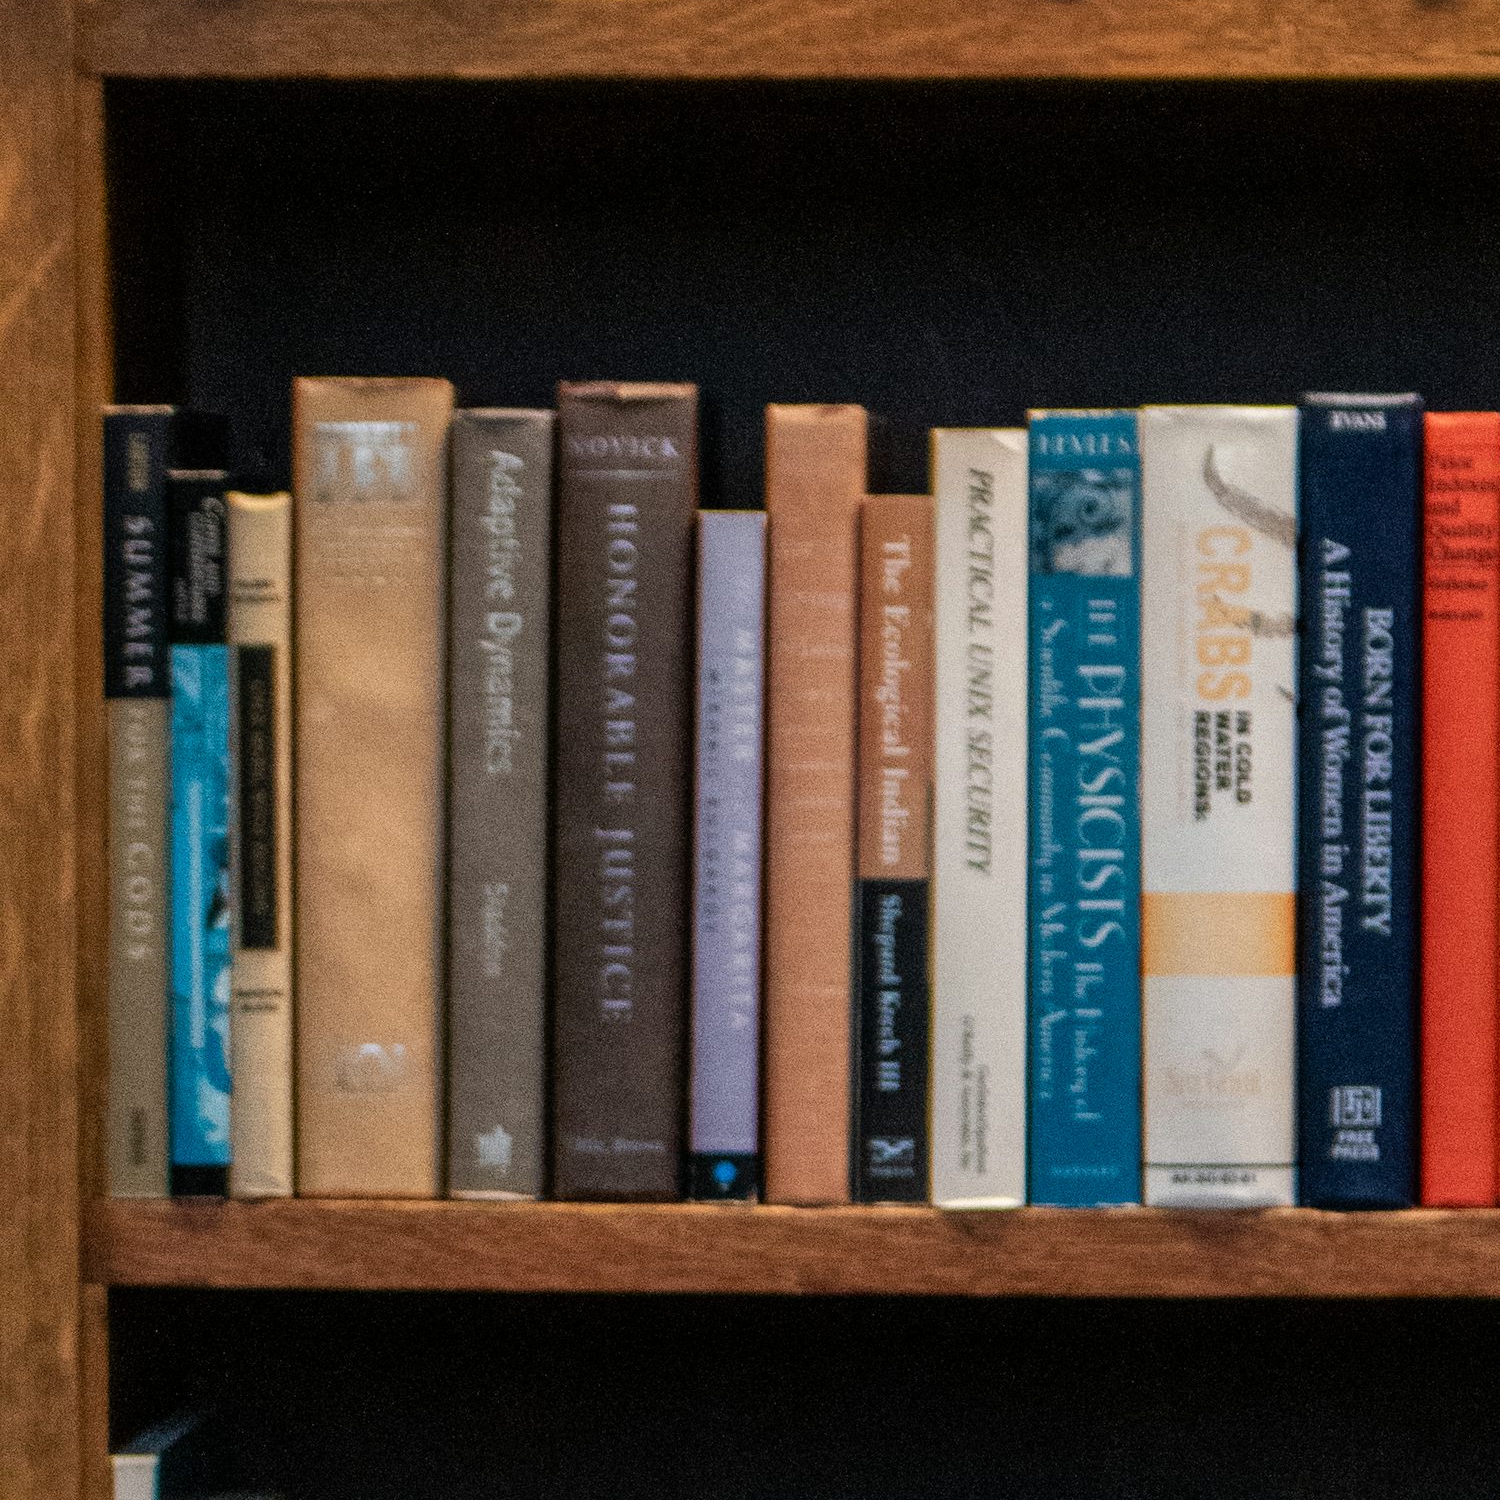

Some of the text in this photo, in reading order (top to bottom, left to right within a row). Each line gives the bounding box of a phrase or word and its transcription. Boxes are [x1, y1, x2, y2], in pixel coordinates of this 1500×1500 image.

[126, 515, 153, 687] SUMMER
[480, 450, 524, 775] Adaptive Dynamics
[876, 534, 912, 865] The Ecological Indian
[967, 467, 994, 876] PRACTICAL UNIX SECURITY
[1198, 525, 1252, 700] CRABS
[601, 503, 639, 1021] HONORABLE JUSTICE
[1078, 664, 1126, 949] PHYSICISTS
[1216, 710, 1231, 791] WATER
[1237, 711, 1251, 804] IN COLD
[1314, 539, 1350, 1007] A History of Women in America
[1363, 607, 1393, 934] BORN FOR LIBERTY
[126, 841, 153, 962] GODS
[730, 830, 753, 1029] MARGARITA
